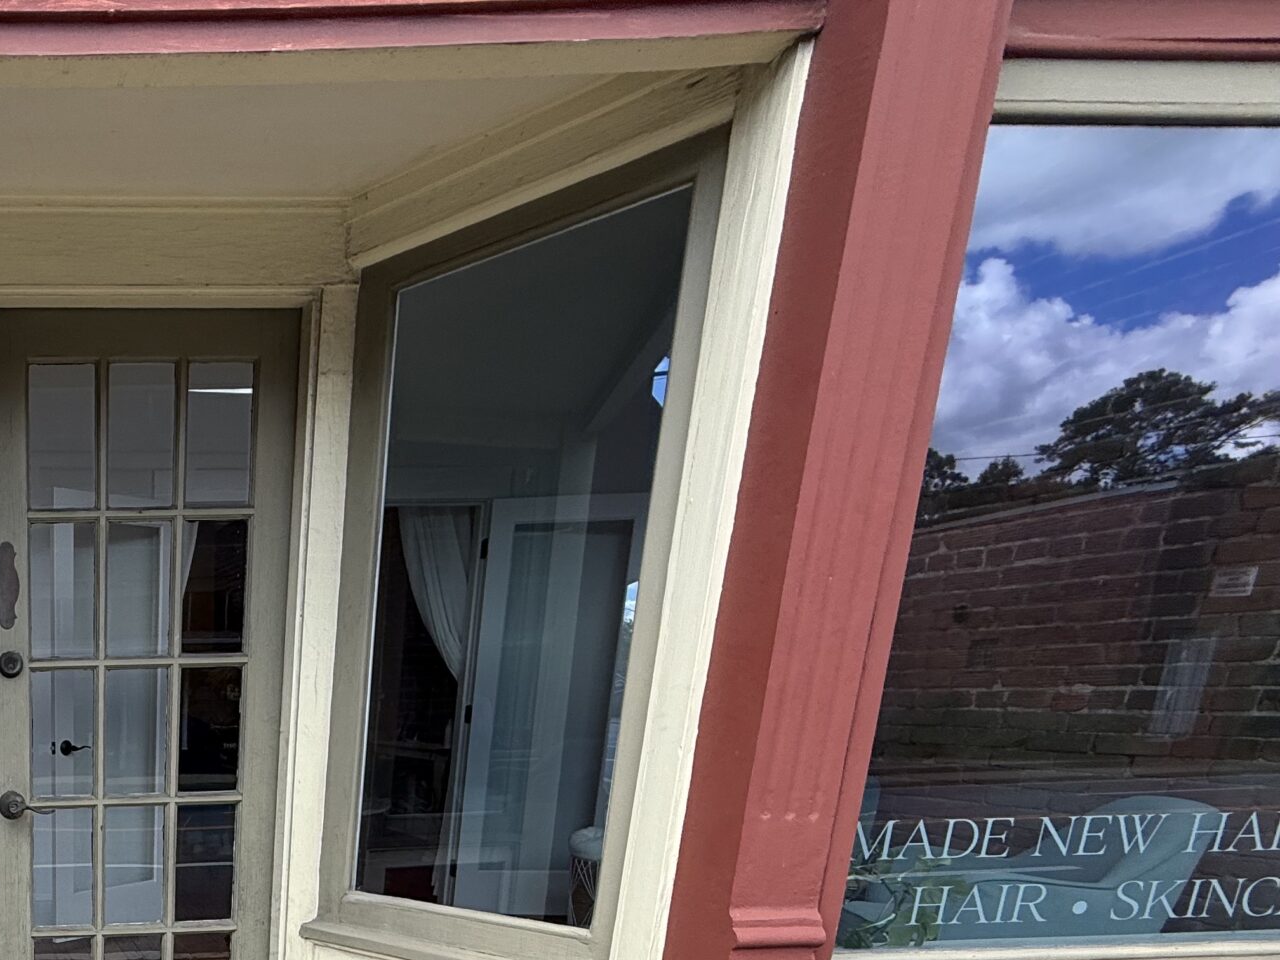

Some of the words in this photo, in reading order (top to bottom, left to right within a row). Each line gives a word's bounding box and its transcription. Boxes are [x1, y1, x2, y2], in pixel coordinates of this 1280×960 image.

[850, 817, 1015, 861] MADE
[1030, 813, 1171, 857] NEW
[905, 883, 1048, 926] HAIR
[1109, 876, 1280, 921] SKINC
